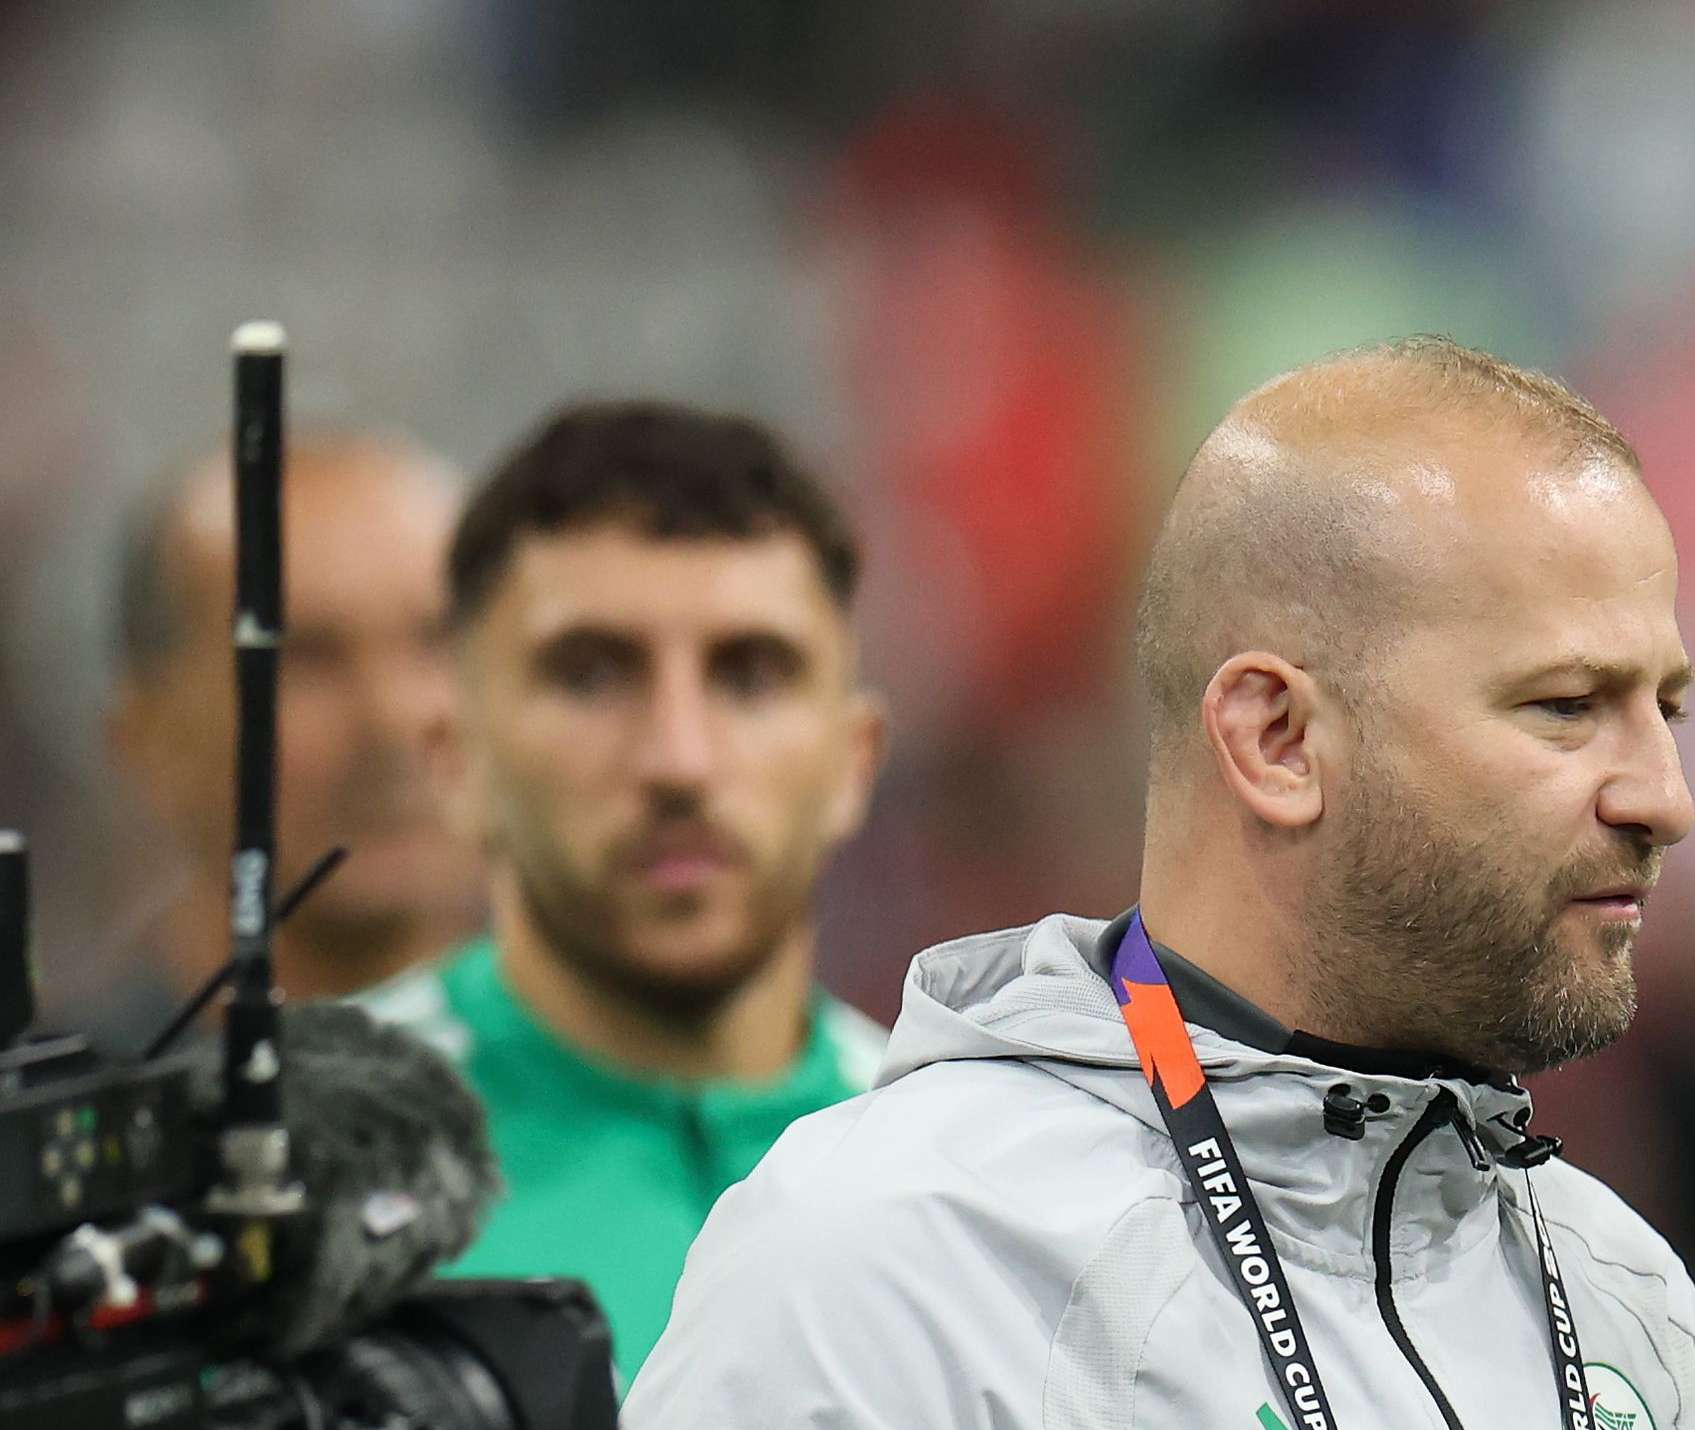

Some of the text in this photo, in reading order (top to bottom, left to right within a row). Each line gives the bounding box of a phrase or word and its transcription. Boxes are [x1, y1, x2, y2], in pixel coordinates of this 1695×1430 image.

[1188, 1137, 1243, 1224] FIFA
[1226, 1219, 1297, 1358] WORLD
[1549, 1282, 1577, 1358] CUP
